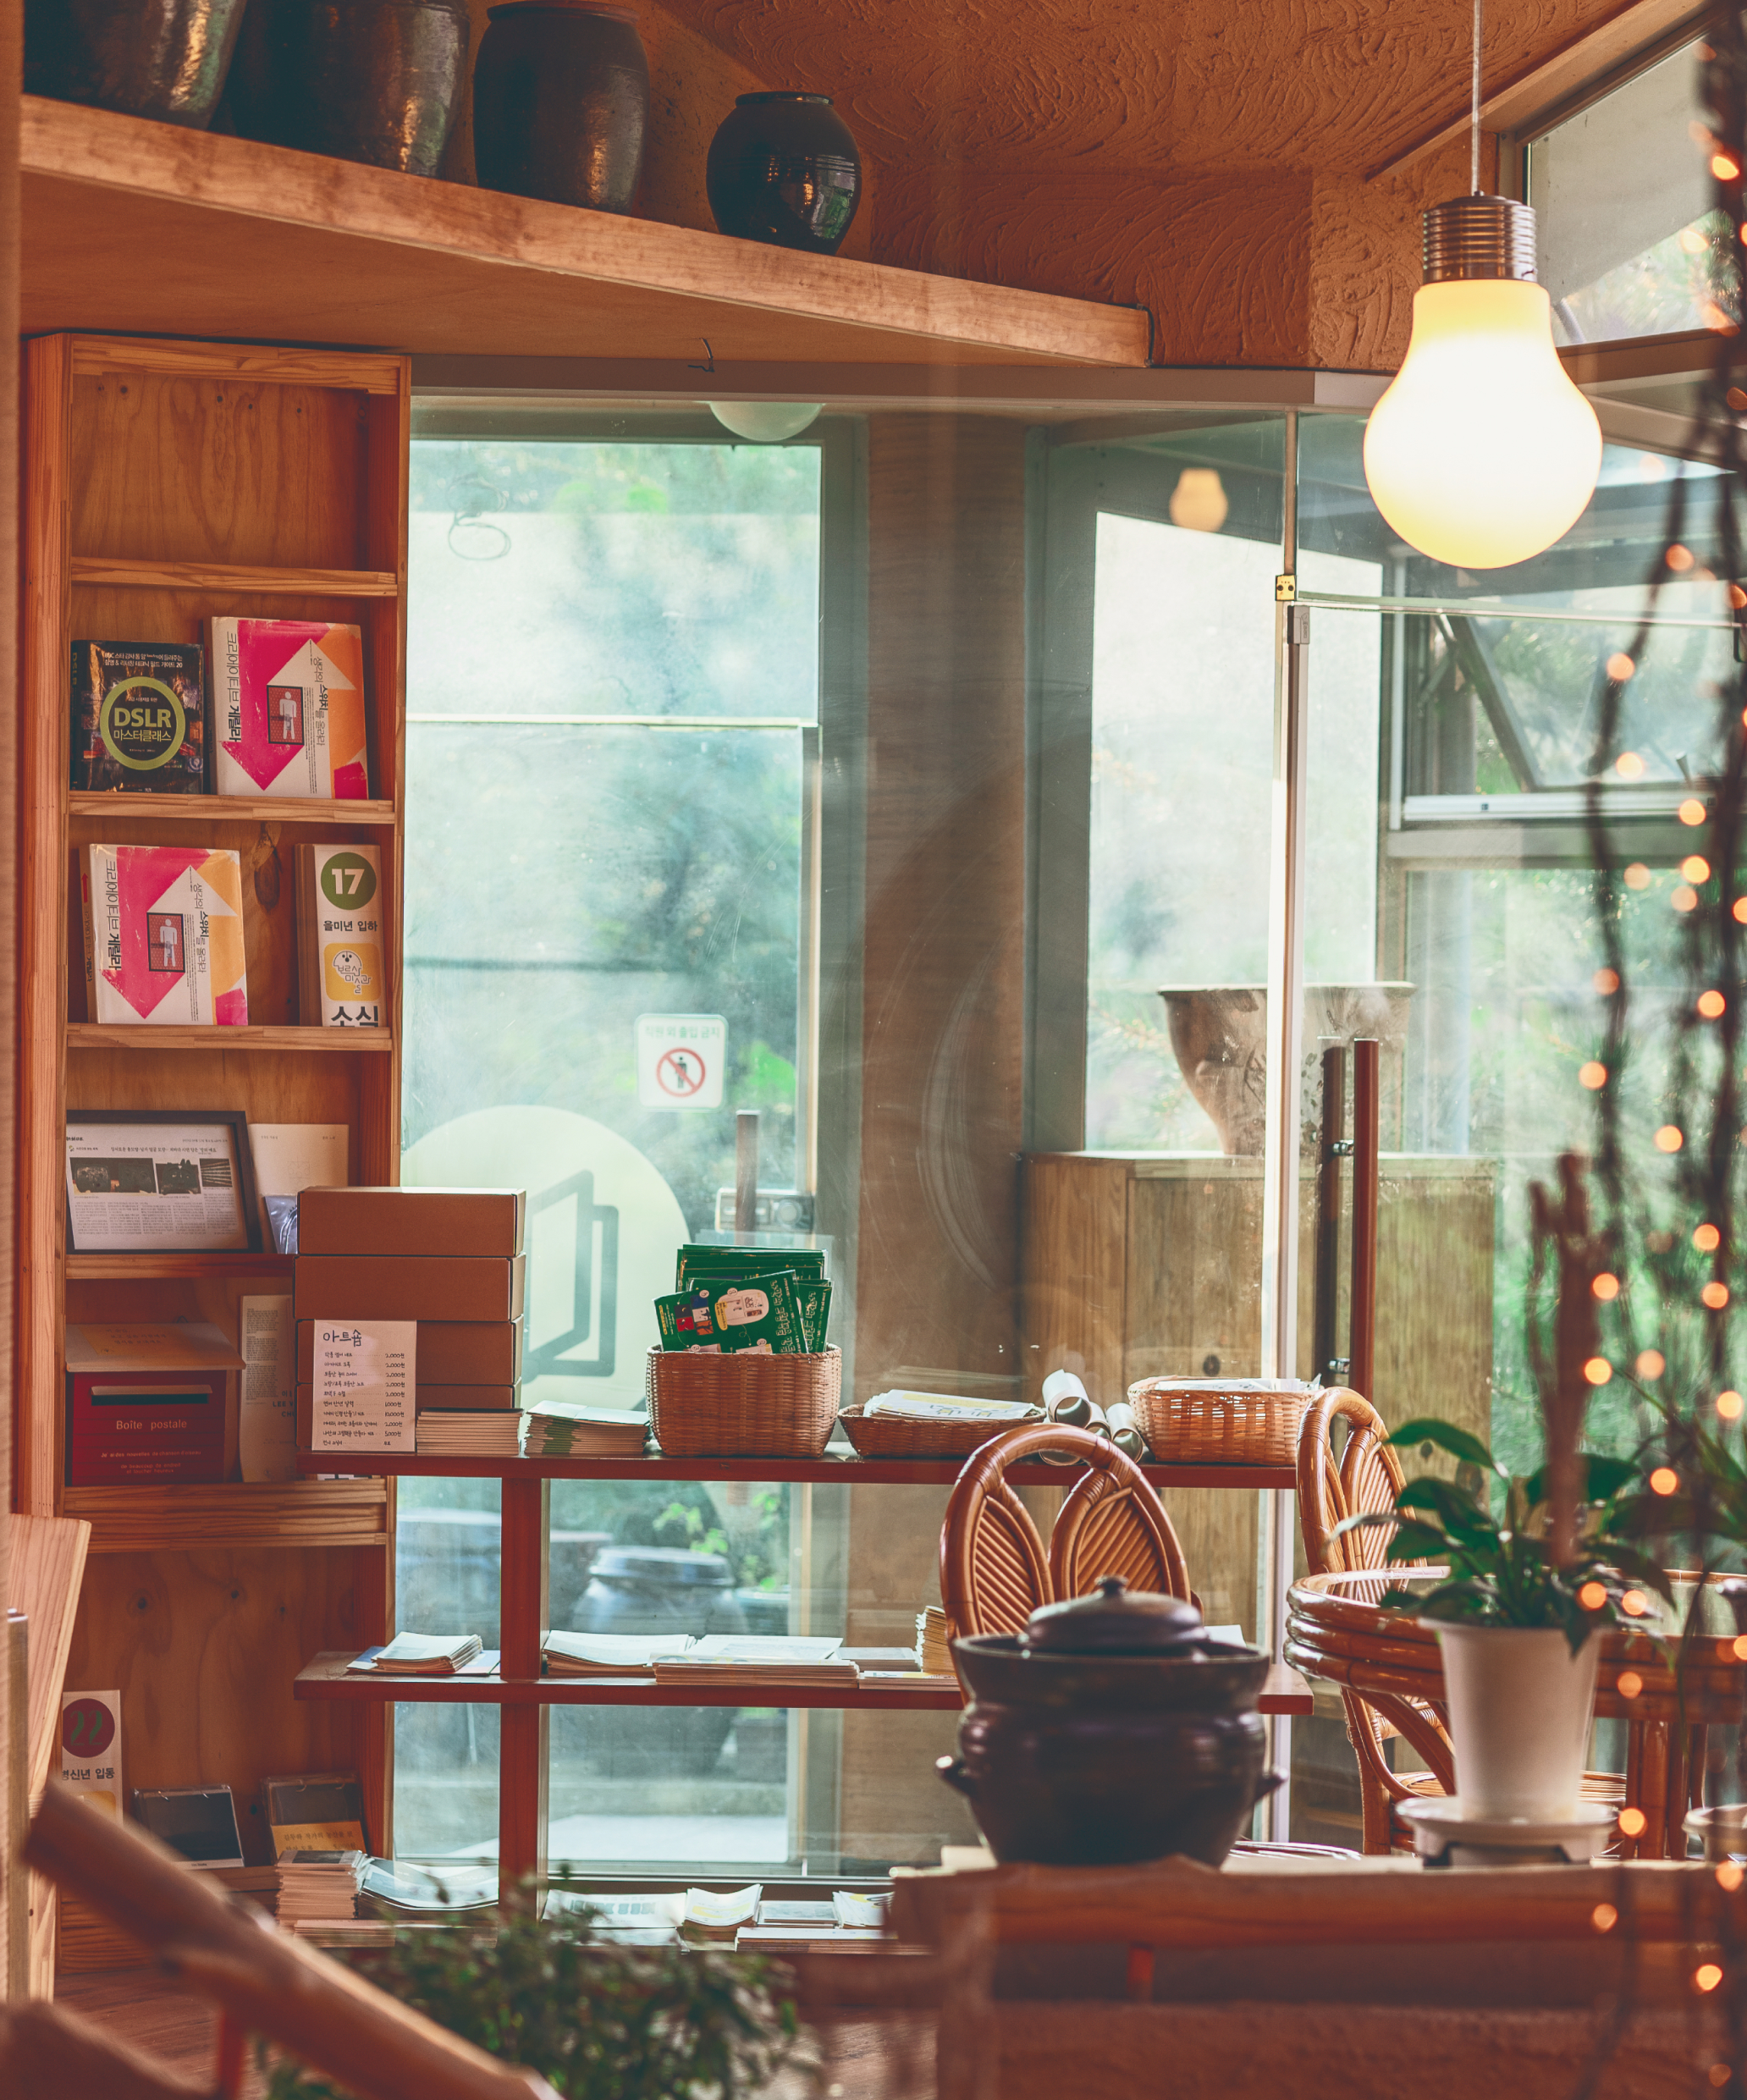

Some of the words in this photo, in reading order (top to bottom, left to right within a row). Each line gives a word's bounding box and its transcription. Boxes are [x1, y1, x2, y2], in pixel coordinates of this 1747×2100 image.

[226, 631, 240, 703] 크리에이티브
[313, 657, 323, 682] 생각의
[316, 684, 328, 719] 스위치를
[114, 708, 172, 728] DSLR
[229, 704, 242, 742] 게릴라
[113, 729, 172, 742] 마스터클래스
[316, 719, 326, 747] 올려라
[104, 858, 120, 931] 크리에이티브
[331, 868, 365, 895] 17
[193, 883, 204, 910] 생각의
[196, 910, 209, 945] 스위치를
[323, 920, 353, 932] 을미년
[357, 920, 378, 932] 입하
[107, 933, 122, 971] 게릴라
[196, 946, 207, 973] 올려라
[322, 1329, 362, 1348] 아트숍
[116, 1419, 143, 1430] Boîte
[151, 1419, 187, 1431] postale
[69, 1709, 104, 1747] 22
[95, 1767, 115, 1779] 입동
